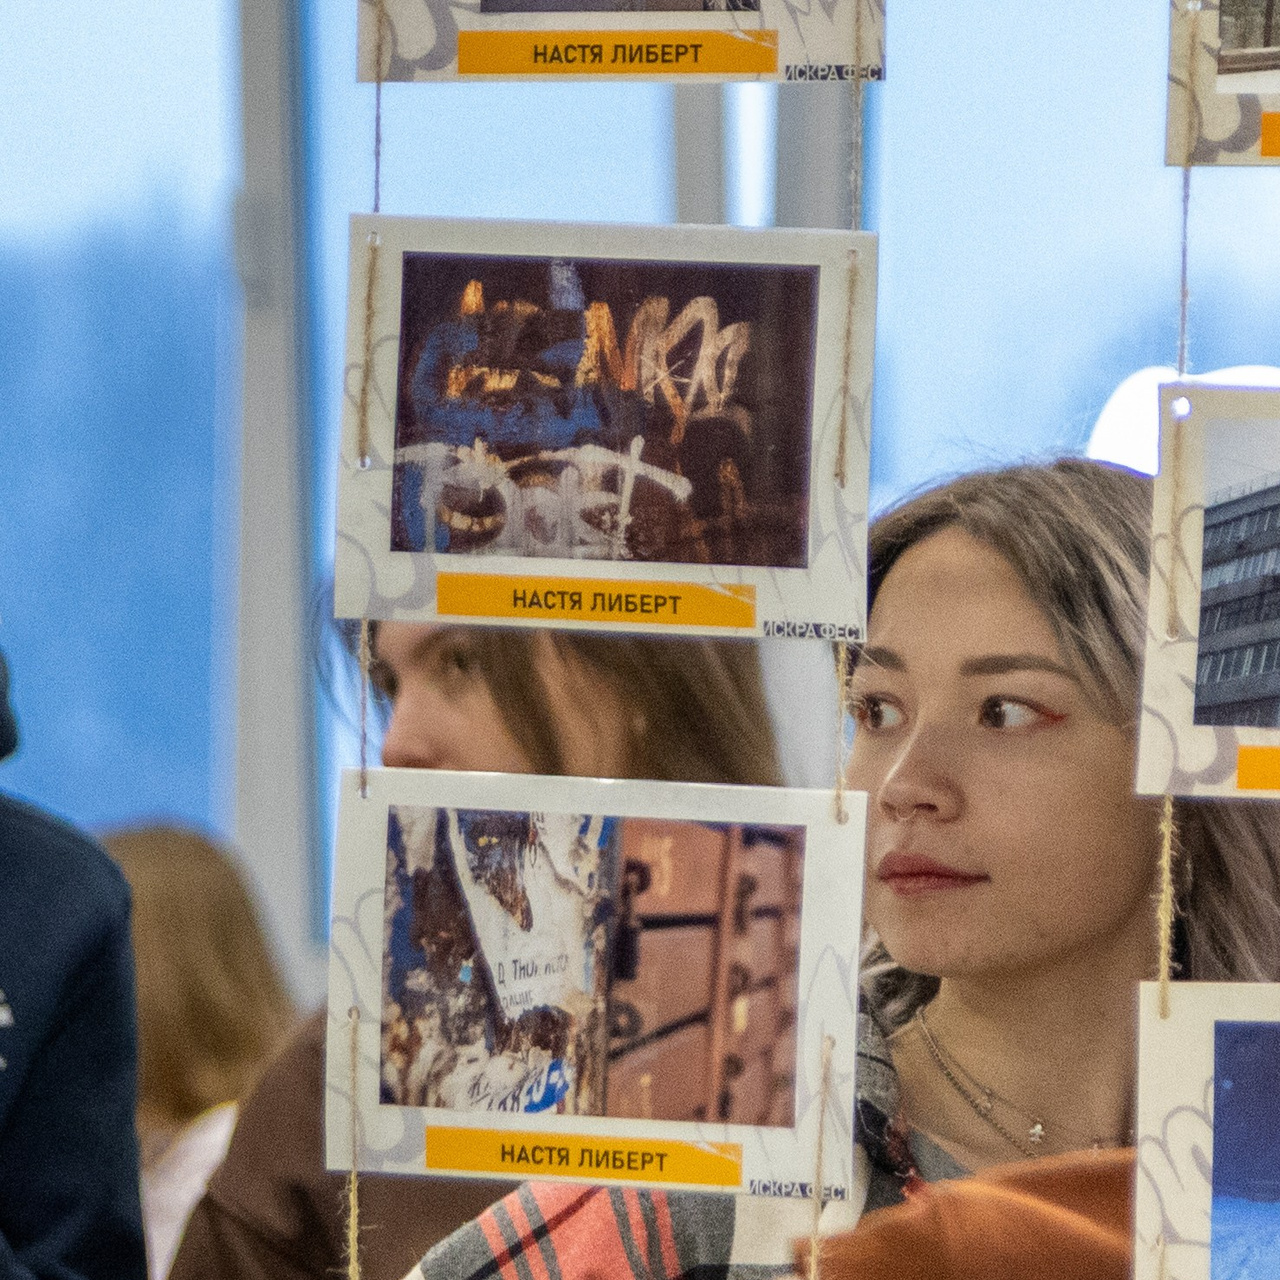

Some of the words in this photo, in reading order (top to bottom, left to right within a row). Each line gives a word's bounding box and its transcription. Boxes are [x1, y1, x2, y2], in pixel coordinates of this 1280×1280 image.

[533, 43, 603, 64] НАСТЯ
[610, 43, 703, 64] ЛИБЕРТ
[785, 65, 839, 81] ИСКРА
[512, 588, 583, 610] НАСТЯ
[590, 591, 683, 615] ЛИБЕРТ
[763, 620, 817, 639] ИСКРА
[500, 1143, 570, 1166] НАСТЯ
[578, 1147, 668, 1172] ЛИБЕРТ
[750, 1179, 804, 1199] ИСКРА
